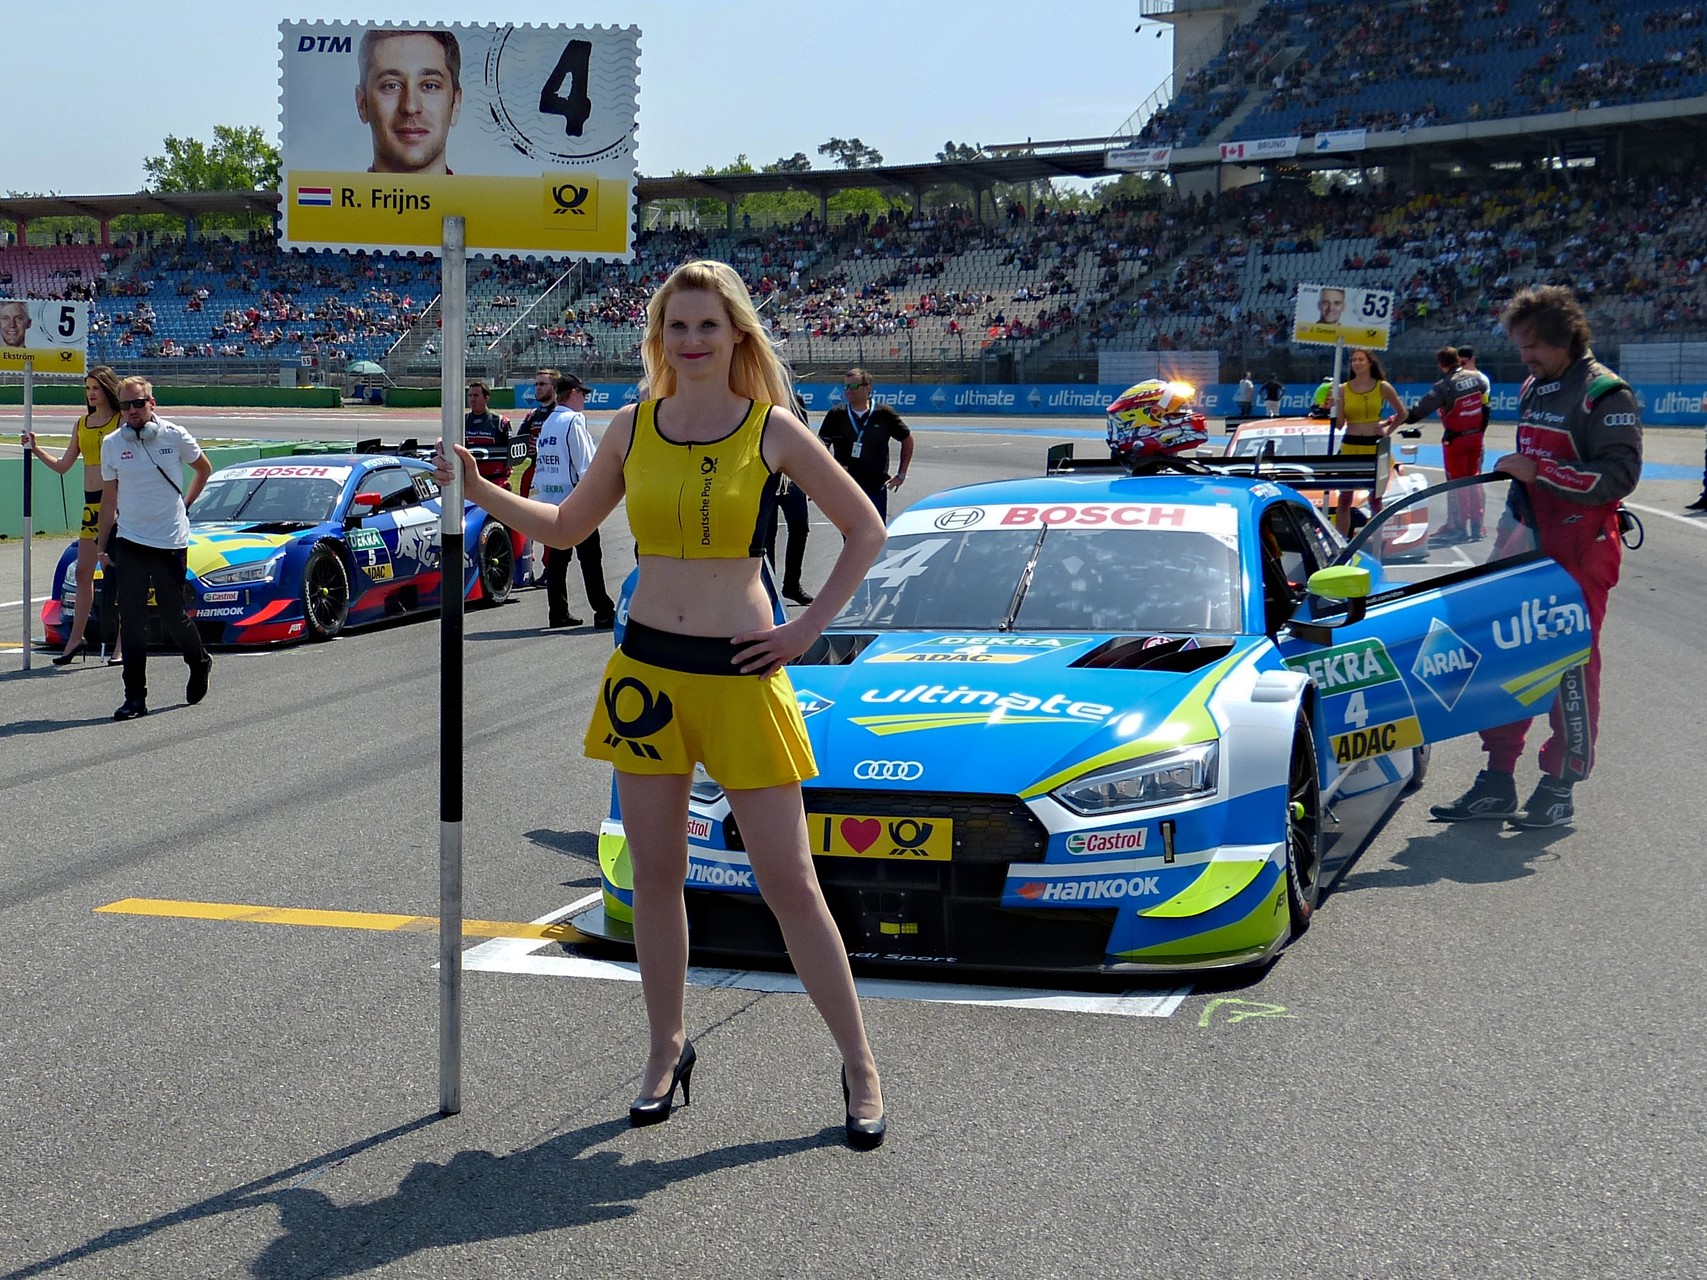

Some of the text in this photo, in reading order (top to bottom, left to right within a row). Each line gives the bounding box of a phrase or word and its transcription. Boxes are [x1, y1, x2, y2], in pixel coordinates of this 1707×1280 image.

[298, 36, 352, 53] DTM
[539, 39, 592, 137] 4
[341, 188, 431, 214] R. Frijns
[1362, 293, 1390, 318] 53
[58, 306, 75, 337] 5
[3, 352, 35, 361] Ekström
[302, 357, 311, 365] 55
[872, 389, 916, 406] imate
[954, 389, 1015, 406] ultimate
[1048, 388, 1113, 407] ultimate
[250, 467, 328, 477] BOSCH
[700, 477, 713, 546] Deutsche Post
[1000, 506, 1185, 527] BOSCH
[350, 534, 382, 547] DEKRA
[368, 549, 377, 566] 5
[864, 538, 952, 588] 4
[212, 592, 237, 601] Castrol
[1491, 594, 1592, 650] ultim
[939, 637, 1063, 648] DEKRA
[904, 653, 994, 662] ADAC
[1422, 647, 1474, 679] ARAL
[798, 701, 821, 712] AL
[860, 684, 1114, 717] ultimate
[1344, 691, 1369, 728] 4
[1566, 673, 1584, 755] Audi Spor
[1336, 724, 1397, 764] ADAC
[687, 819, 709, 838] strol
[823, 817, 832, 852] I
[1086, 830, 1142, 852] Castrol
[883, 953, 958, 963] Sport
